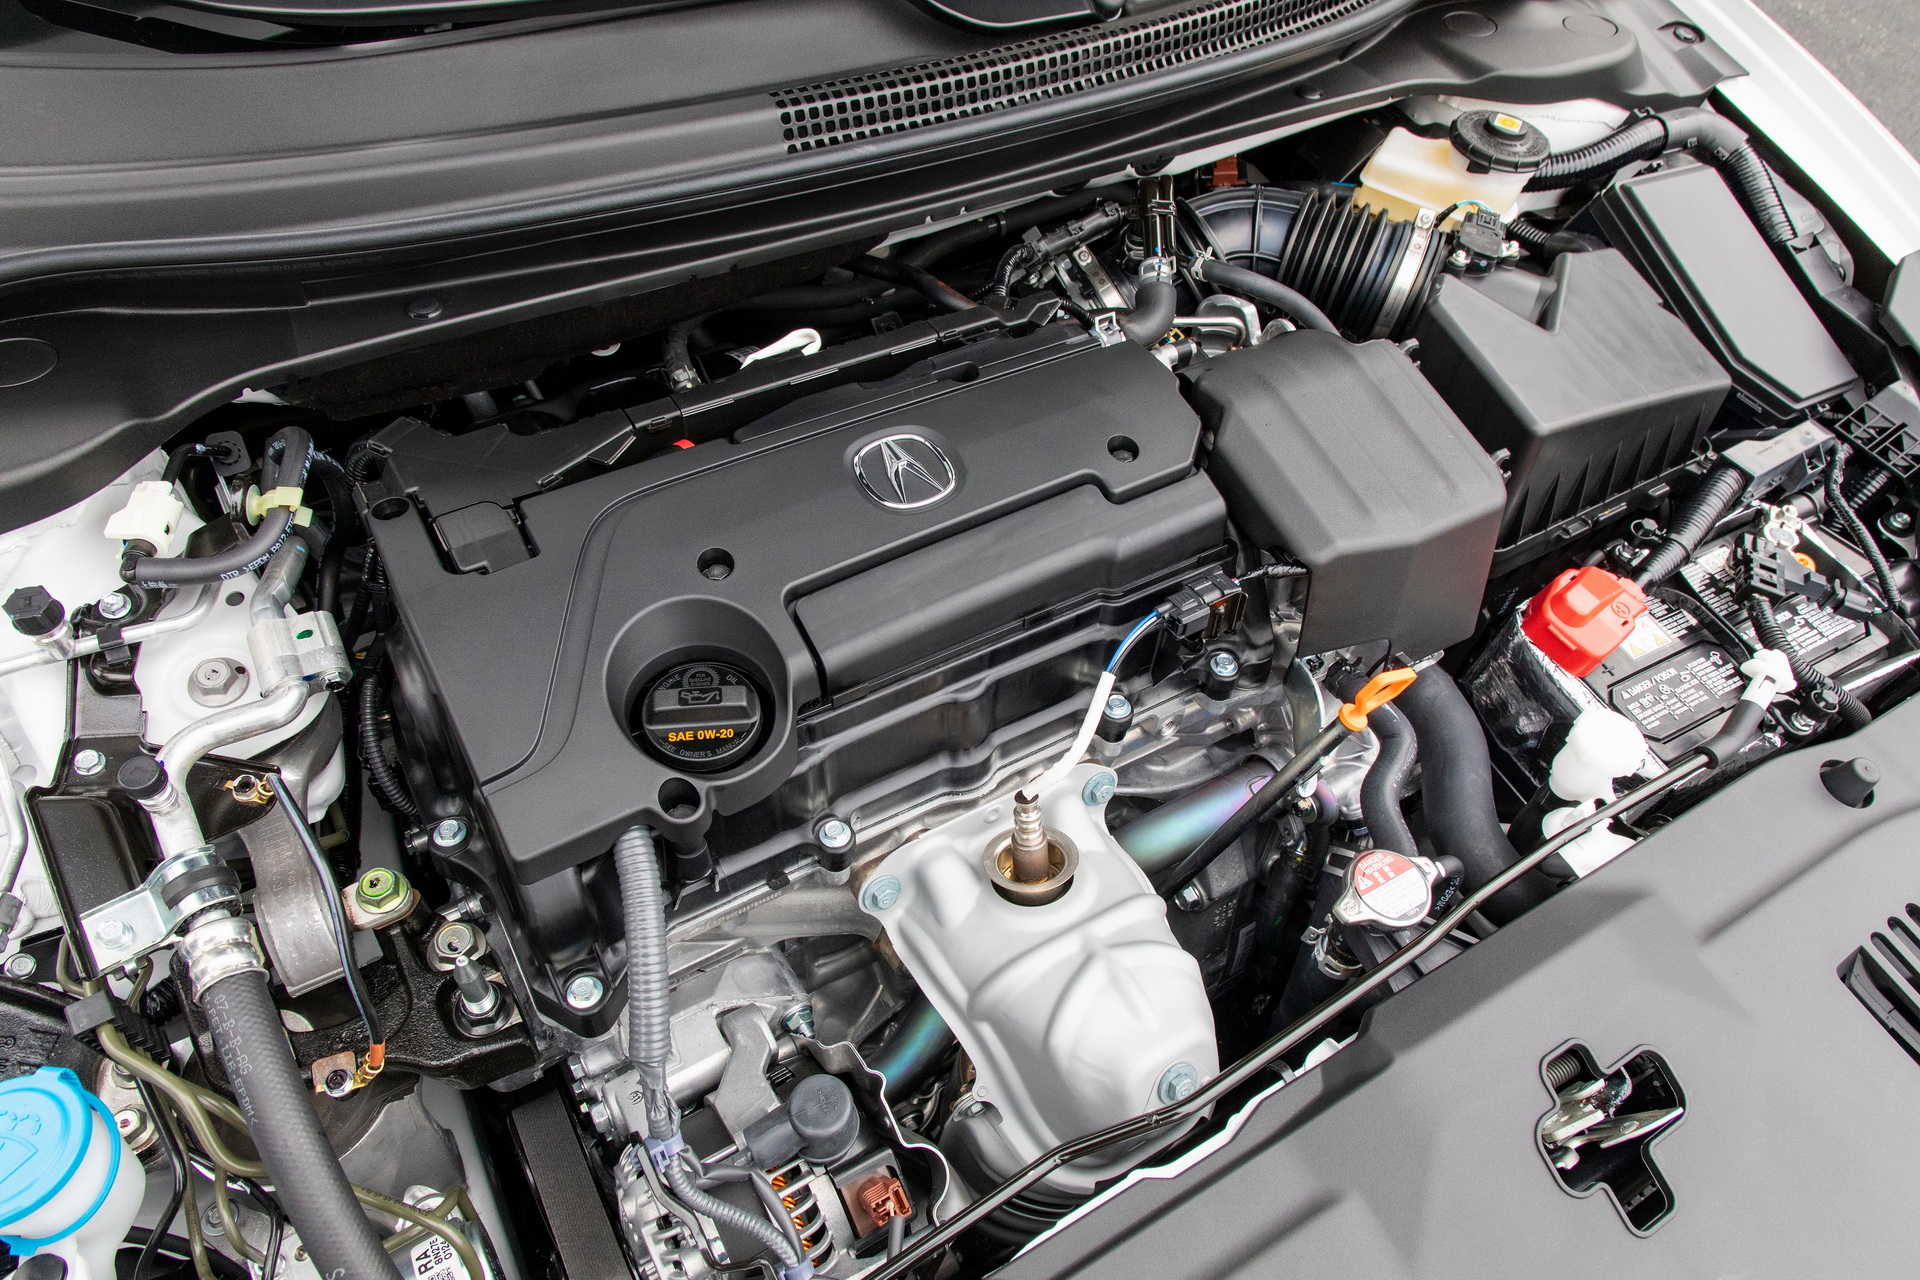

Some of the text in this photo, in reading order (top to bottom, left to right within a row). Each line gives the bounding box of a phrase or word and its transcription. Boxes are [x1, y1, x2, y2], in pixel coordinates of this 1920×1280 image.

[658, 673, 739, 690] NGINE OIL
[668, 728, 734, 742] SAE 0W-20
[662, 737, 743, 758] SEE OWNER'S MANUAL
[1360, 853, 1384, 869] DANGER
[415, 1248, 434, 1276] RA
